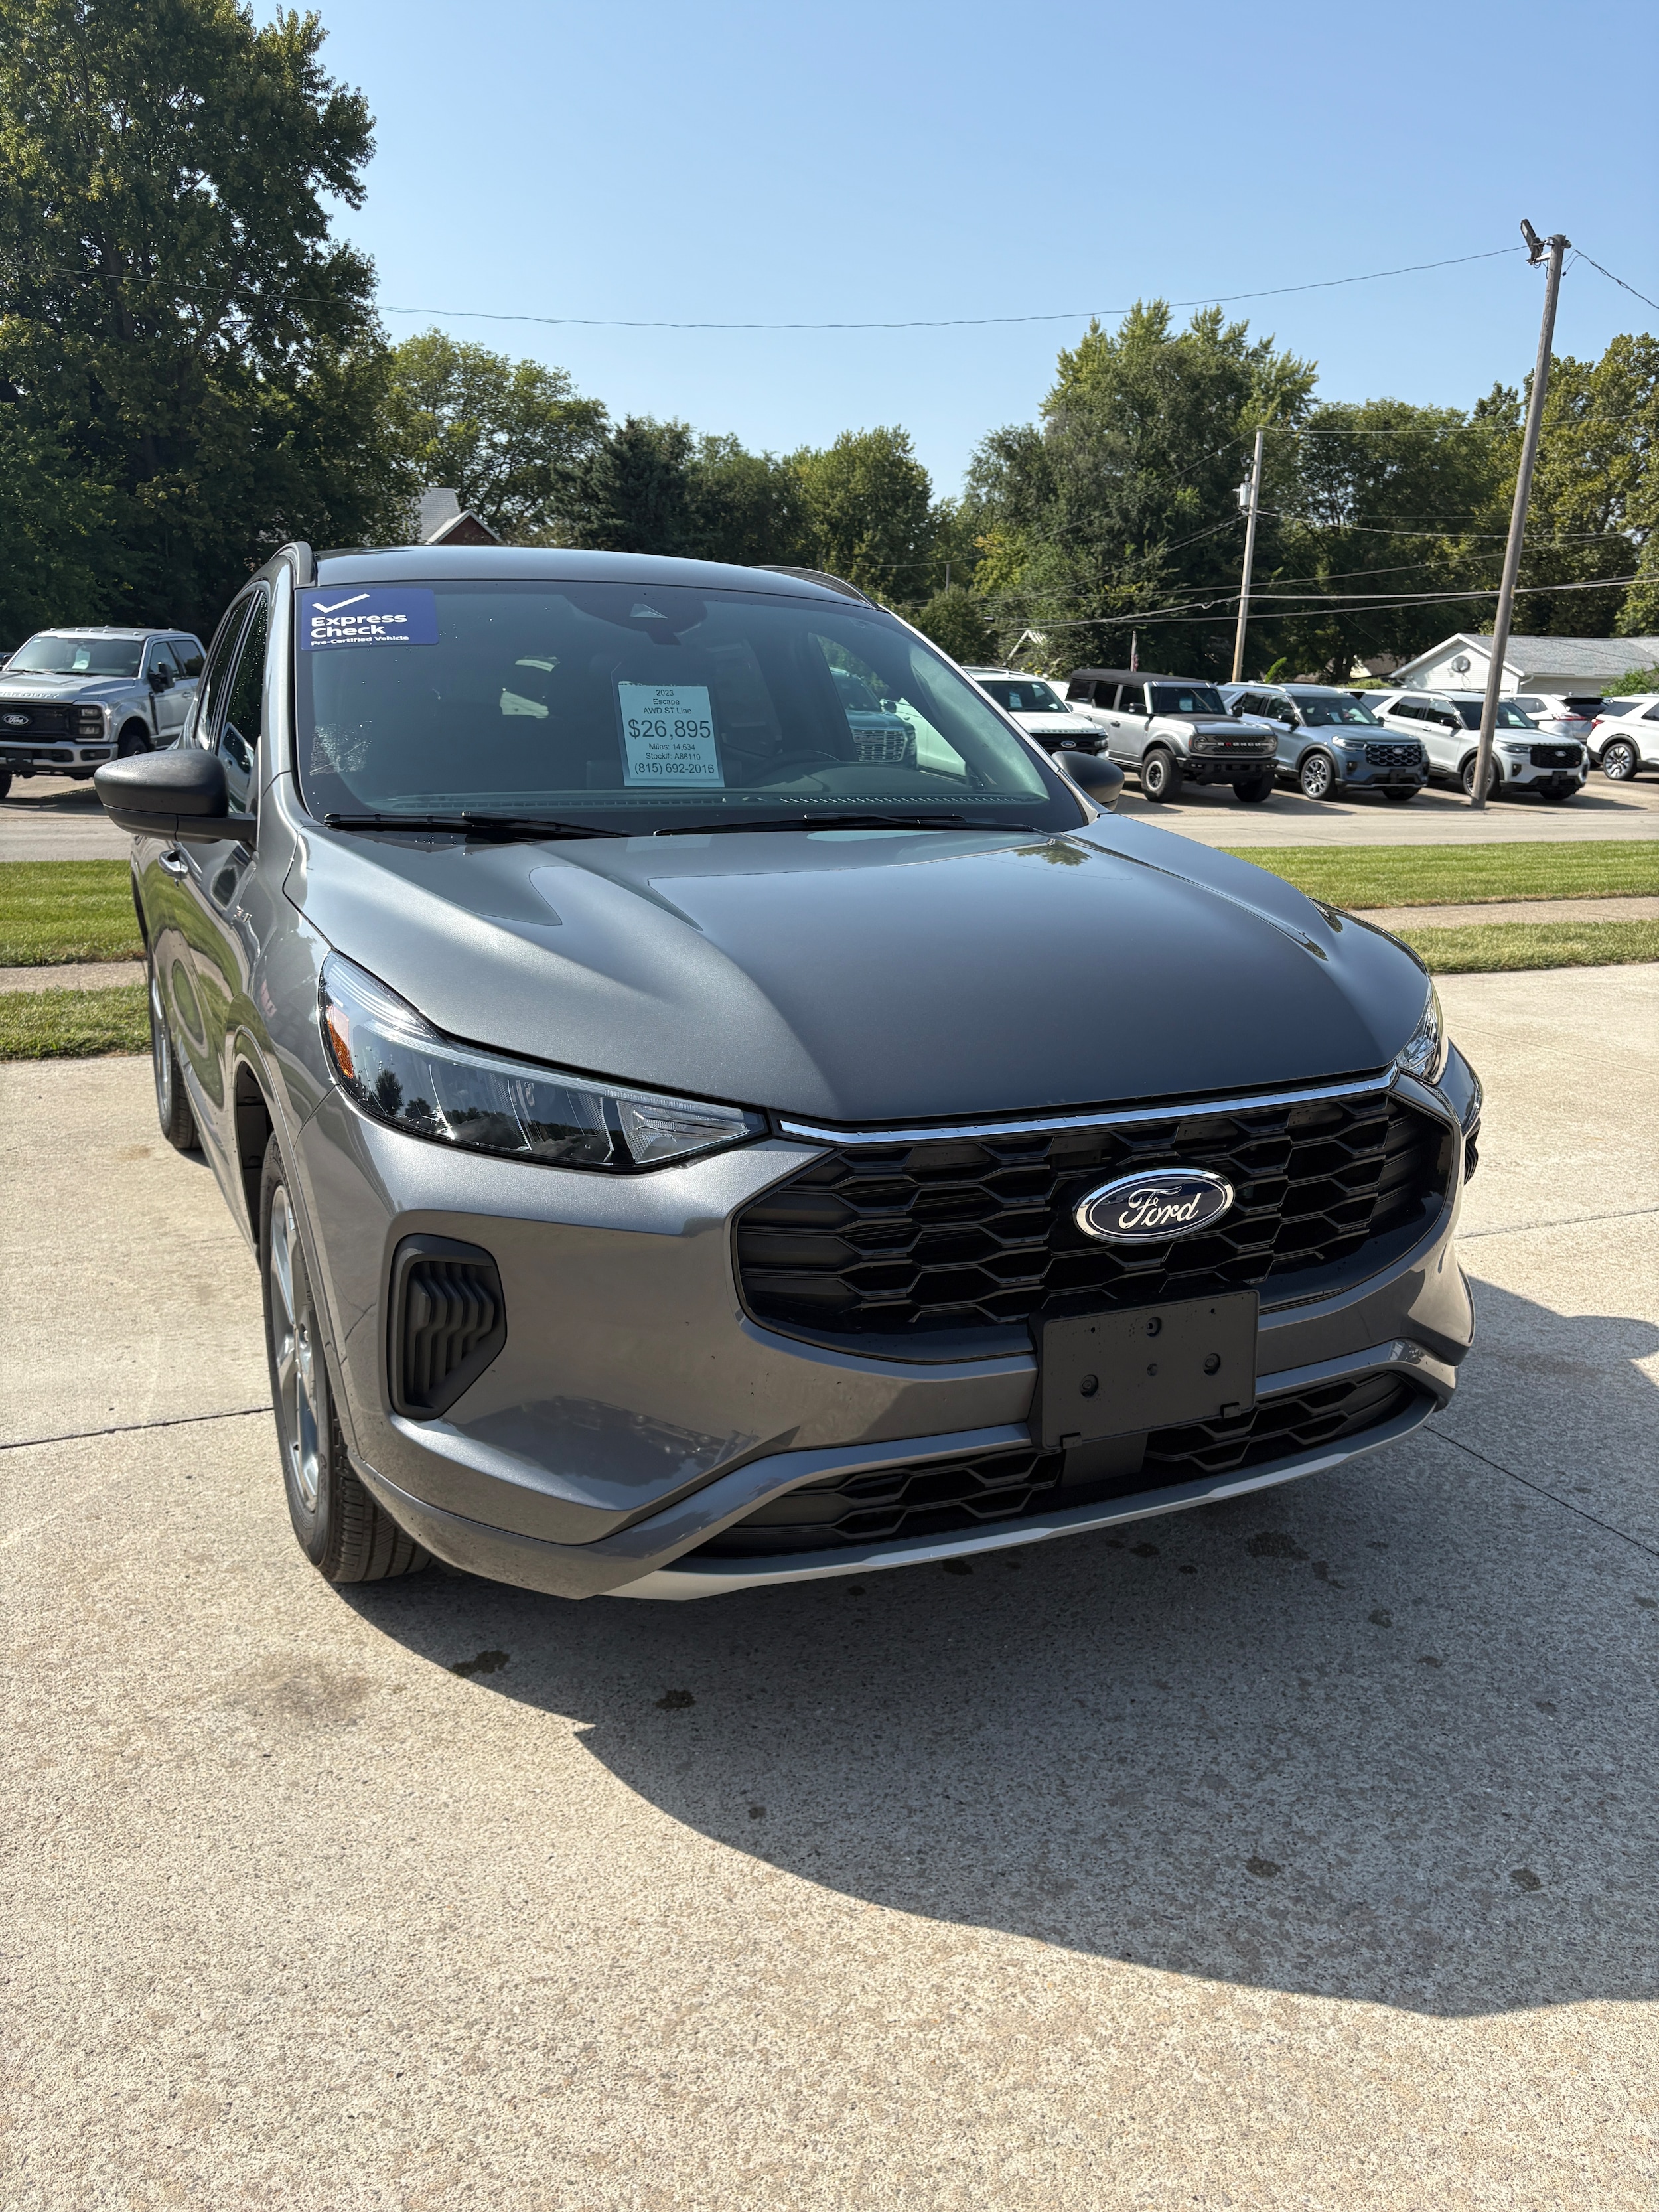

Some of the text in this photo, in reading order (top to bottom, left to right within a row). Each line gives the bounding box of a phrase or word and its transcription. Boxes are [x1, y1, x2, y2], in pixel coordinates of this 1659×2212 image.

[311, 614, 408, 627] Express
[311, 624, 386, 638] Check
[311, 636, 372, 646] Pre-Certified
[628, 719, 711, 741] $26,895
[634, 763, 715, 774] (815) 692-2016
[1118, 1185, 1202, 1230] Ford
